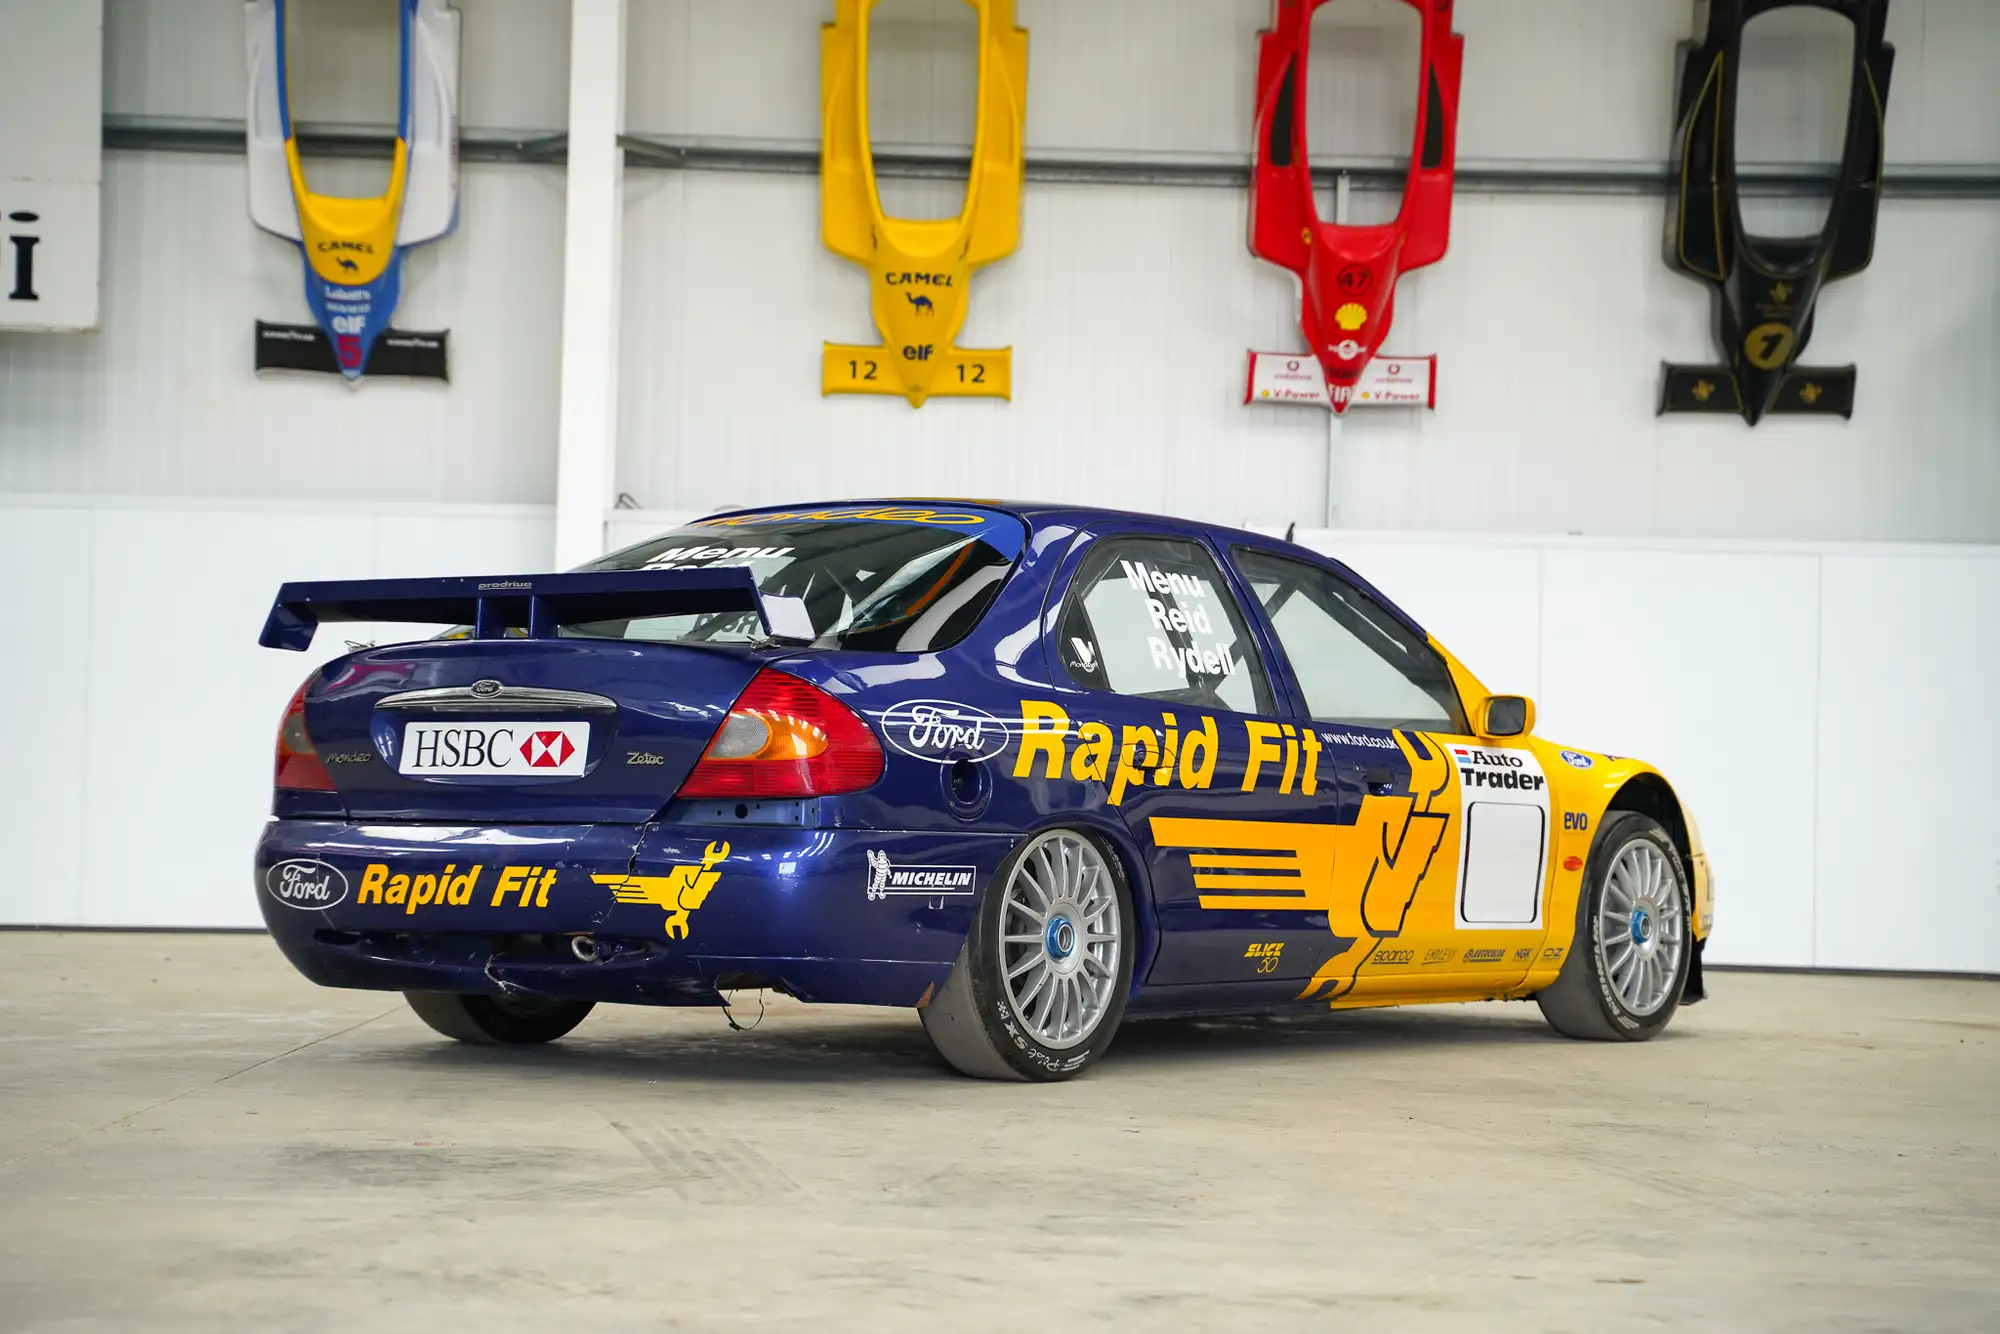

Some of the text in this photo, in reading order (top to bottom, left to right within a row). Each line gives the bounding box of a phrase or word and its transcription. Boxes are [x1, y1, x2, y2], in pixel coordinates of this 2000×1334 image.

[0, 210, 41, 302] i
[317, 240, 374, 254] CAMEL
[885, 272, 953, 287] CAMEL
[1340, 272, 1368, 287] 47
[331, 315, 366, 334] elf
[337, 335, 362, 368] 5
[902, 343, 934, 361] elf
[1760, 333, 1786, 360] 7
[848, 360, 878, 381] 12
[956, 364, 986, 383] 12
[645, 545, 796, 564] Menu
[1120, 560, 1206, 598] Menu
[1143, 598, 1214, 635] Reid
[1147, 636, 1236, 679] Rydell
[476, 682, 495, 693] Ford
[908, 704, 986, 750] Ford
[412, 729, 514, 768] HSBC
[1320, 732, 1400, 750] www.ford.co.uk
[626, 752, 665, 765] Zetec
[1012, 700, 1323, 806] Rapid Fit
[1471, 750, 1524, 769] Auto
[1460, 767, 1546, 791] Trader
[1564, 812, 1588, 831] evo
[279, 863, 331, 901] Ford
[891, 872, 973, 886] MICHELIN
[356, 863, 557, 915] Rapid Fit
[1243, 942, 1285, 958] SLICK
[1374, 949, 1415, 962] sparco
[1543, 948, 1564, 957] OZ
[1257, 957, 1279, 973] 50
[1004, 1021, 1060, 1072] Pilot SX
